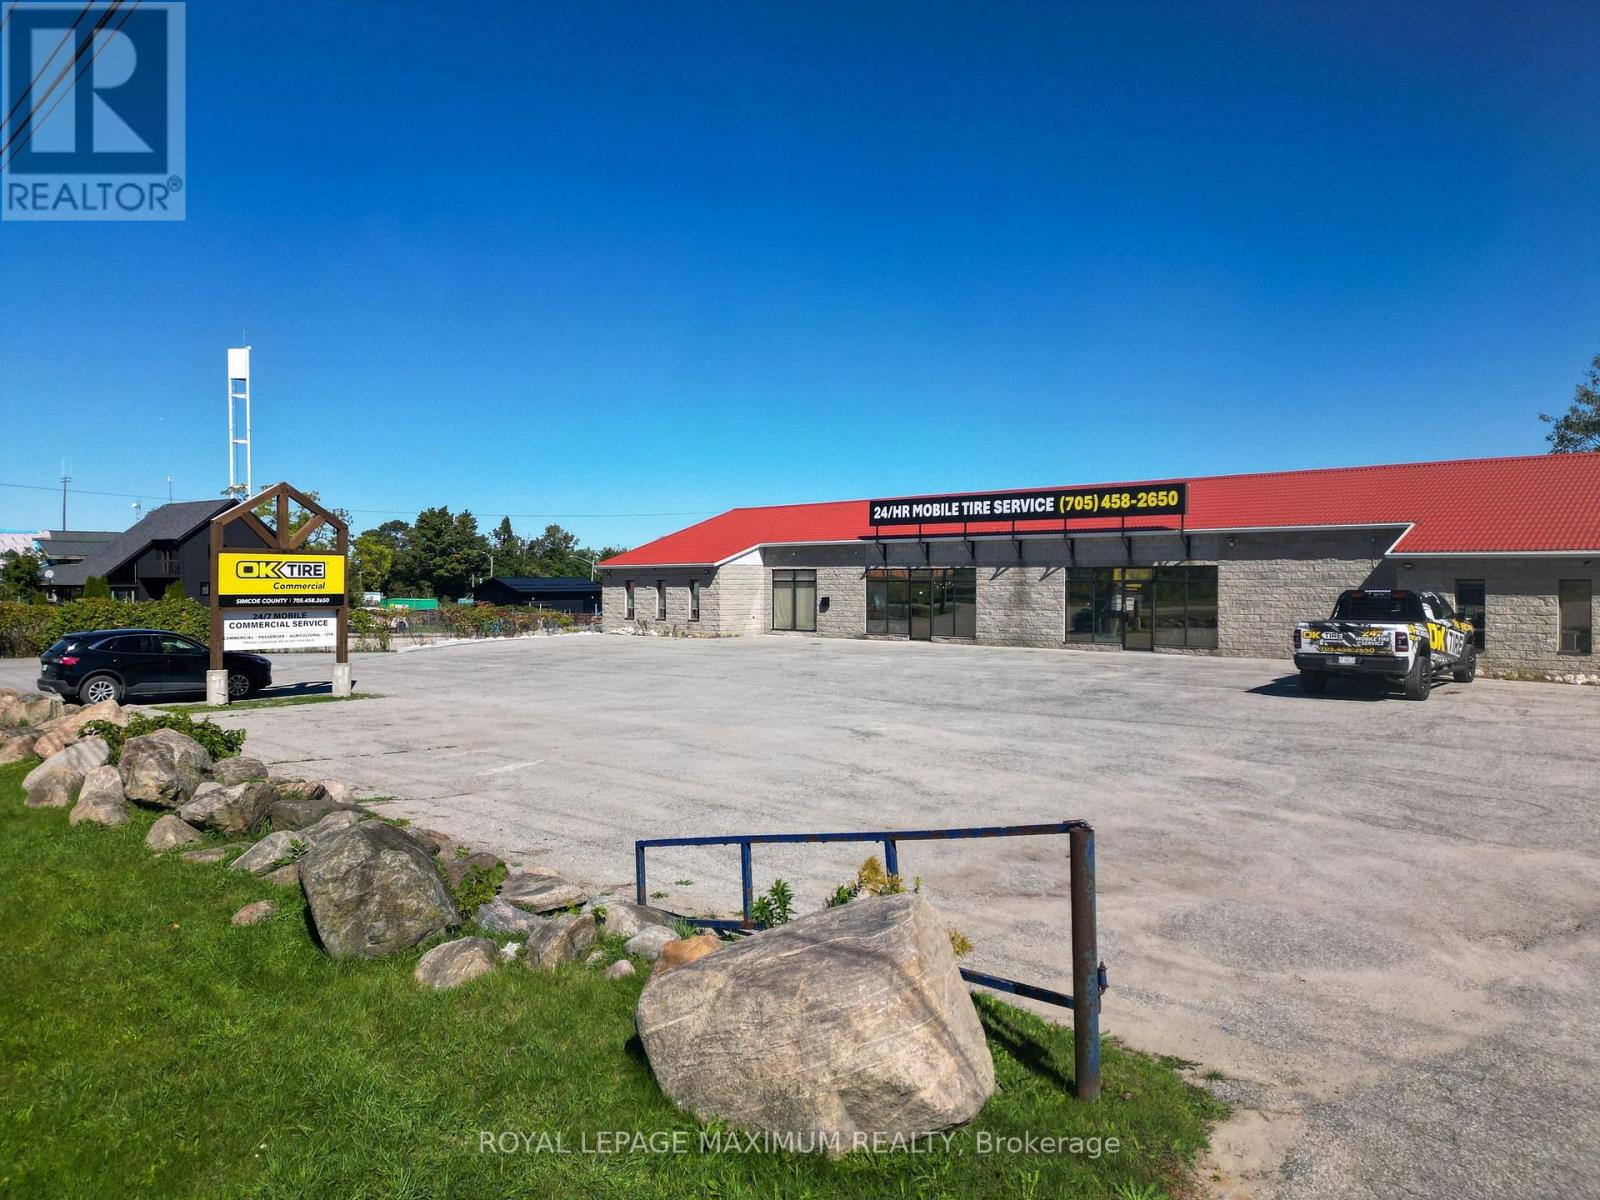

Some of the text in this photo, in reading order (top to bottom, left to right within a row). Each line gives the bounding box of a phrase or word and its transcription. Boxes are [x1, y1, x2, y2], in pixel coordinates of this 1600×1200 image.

[874, 490, 1179, 519] 24/HR MOBILE TIRE SERVICE (705) 458-2650
[237, 561, 323, 578] OK TIRE
[273, 582, 326, 590] Commercial
[229, 620, 328, 629] COMMERCIAL SERVICE
[1303, 630, 1343, 640] OK TIRE
[1427, 623, 1446, 652] OK
